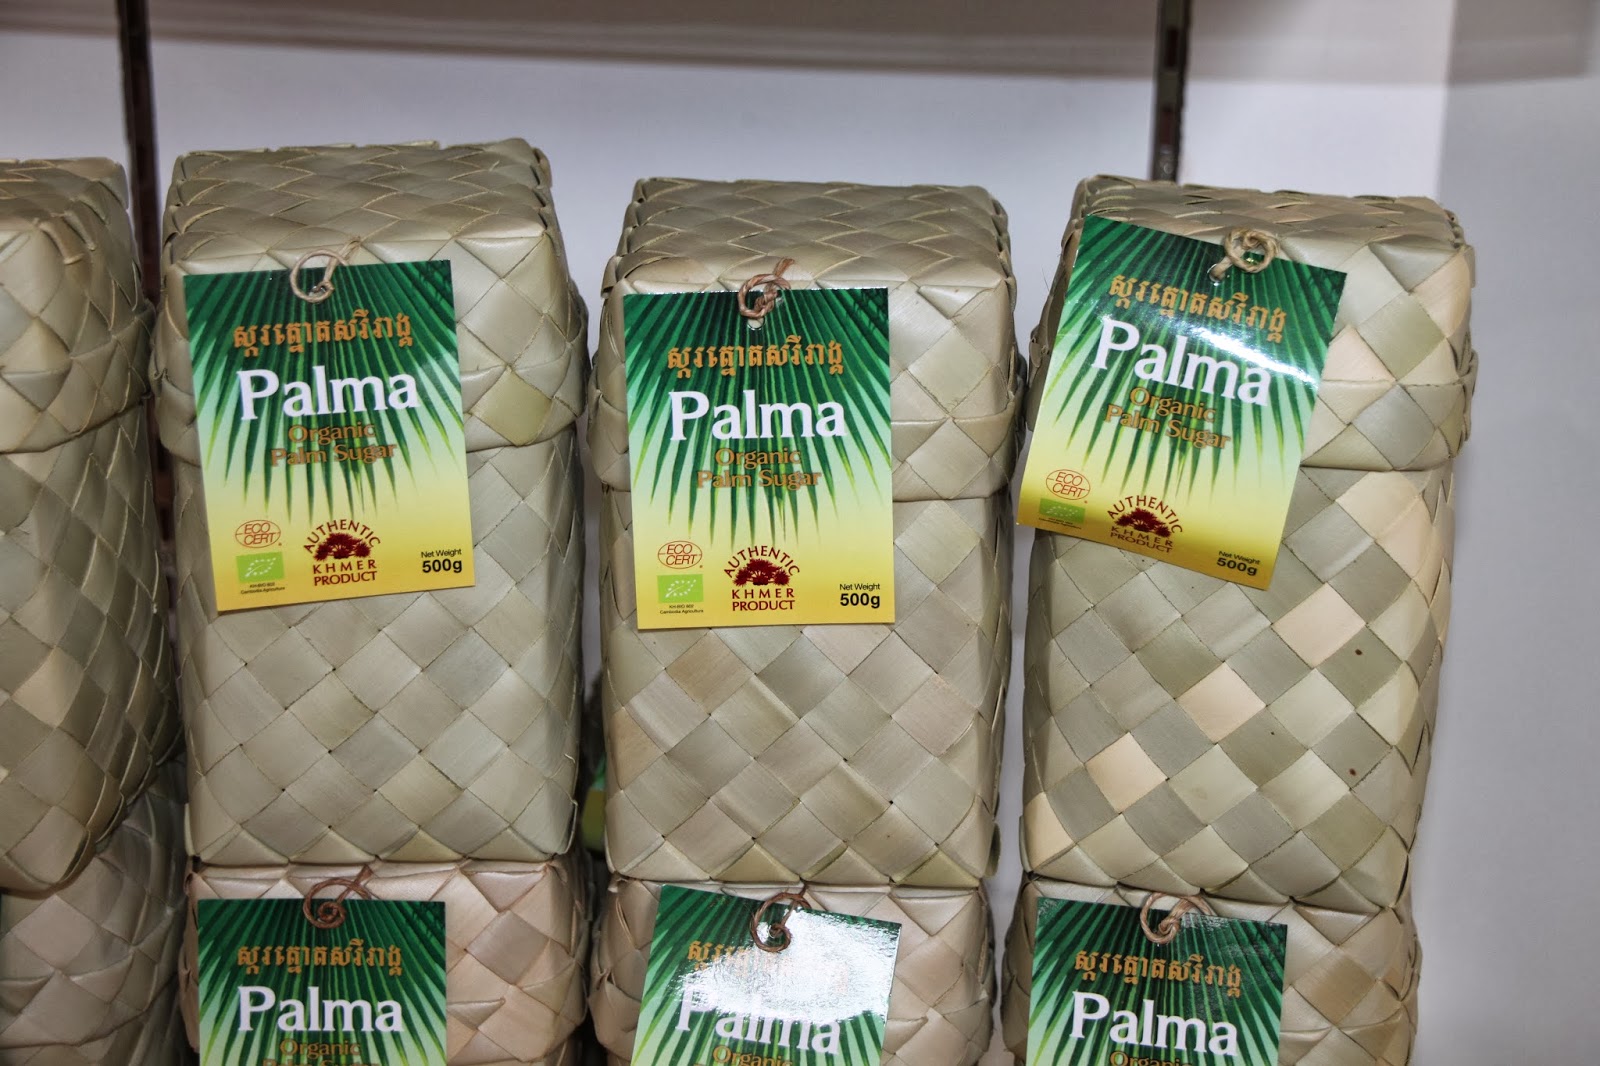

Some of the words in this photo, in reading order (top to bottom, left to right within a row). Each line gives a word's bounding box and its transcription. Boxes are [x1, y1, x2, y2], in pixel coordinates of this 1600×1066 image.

[1091, 317, 1272, 407] Palma
[237, 365, 420, 420] Palma
[1130, 386, 1216, 423] Organic
[668, 389, 848, 441] Palma
[288, 421, 375, 445] Organic
[1104, 404, 1161, 434] Palm
[1166, 419, 1231, 450] Sugar
[270, 447, 327, 467] Palm
[333, 443, 398, 463] Sugar
[715, 447, 802, 469] Organic
[697, 468, 752, 488] Palm
[758, 469, 822, 491] Sugar
[1055, 471, 1083, 486] ECO
[1052, 482, 1086, 498] CERT
[1107, 495, 1183, 534] AUTHENTIC
[244, 522, 271, 534] ECO
[303, 519, 381, 554] AUTHENTIC
[1111, 526, 1173, 547] KHMER
[244, 533, 276, 545] CERT
[1110, 532, 1173, 553] PRODUCT
[421, 550, 434, 558] Net
[435, 548, 462, 559] Weight
[666, 544, 693, 555] ECO
[1233, 554, 1261, 565] Weight
[313, 559, 377, 574] KHMER
[422, 558, 463, 573] 500g
[666, 554, 698, 566] CERT
[723, 545, 800, 579] AUTHENTIC
[1217, 557, 1257, 576] 500g
[314, 571, 377, 586] PRODUCT
[839, 583, 852, 591] Net
[853, 582, 880, 592] Weight
[732, 588, 795, 599] KHMER
[839, 593, 880, 608] 500g
[733, 600, 795, 612] PRODUCT
[238, 986, 404, 1032] Palma
[1070, 990, 1239, 1057] Palma
[279, 1038, 361, 1060] Organic
[1110, 1051, 1193, 1066] Orga
